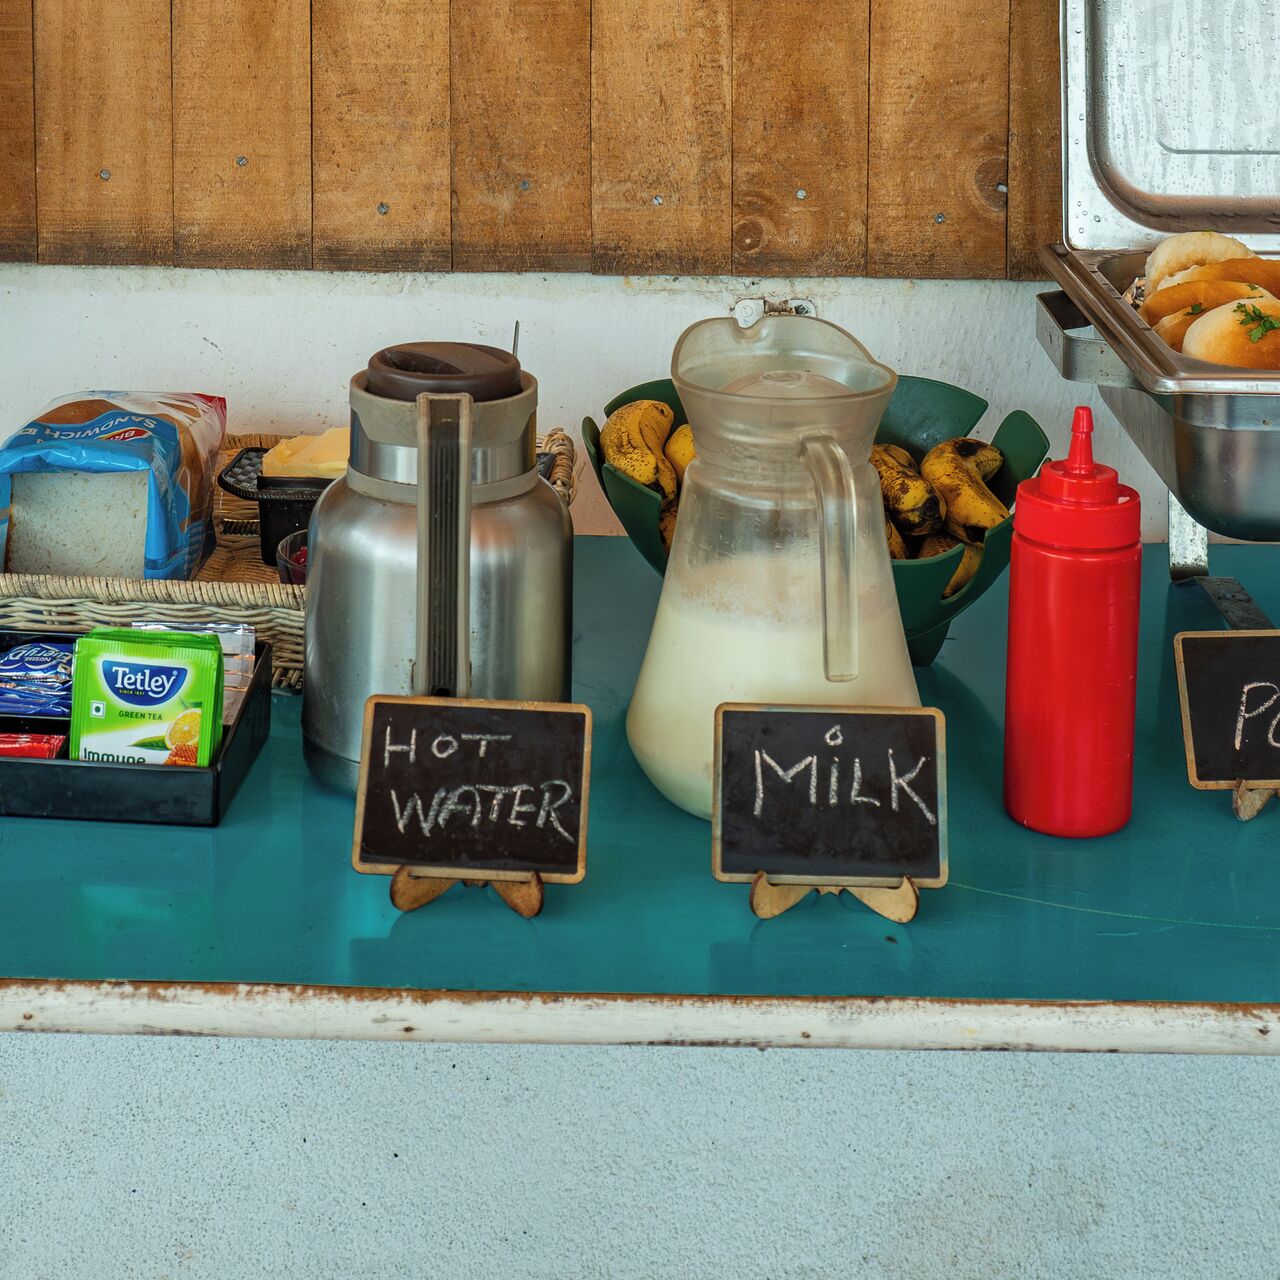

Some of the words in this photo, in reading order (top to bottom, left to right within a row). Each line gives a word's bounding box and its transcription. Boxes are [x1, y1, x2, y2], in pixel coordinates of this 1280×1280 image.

[44, 415, 157, 439] SANDWICH
[112, 666, 176, 698] Tetley
[118, 710, 146, 719] GREEN
[384, 725, 512, 767] HOT
[390, 780, 575, 844] WATER
